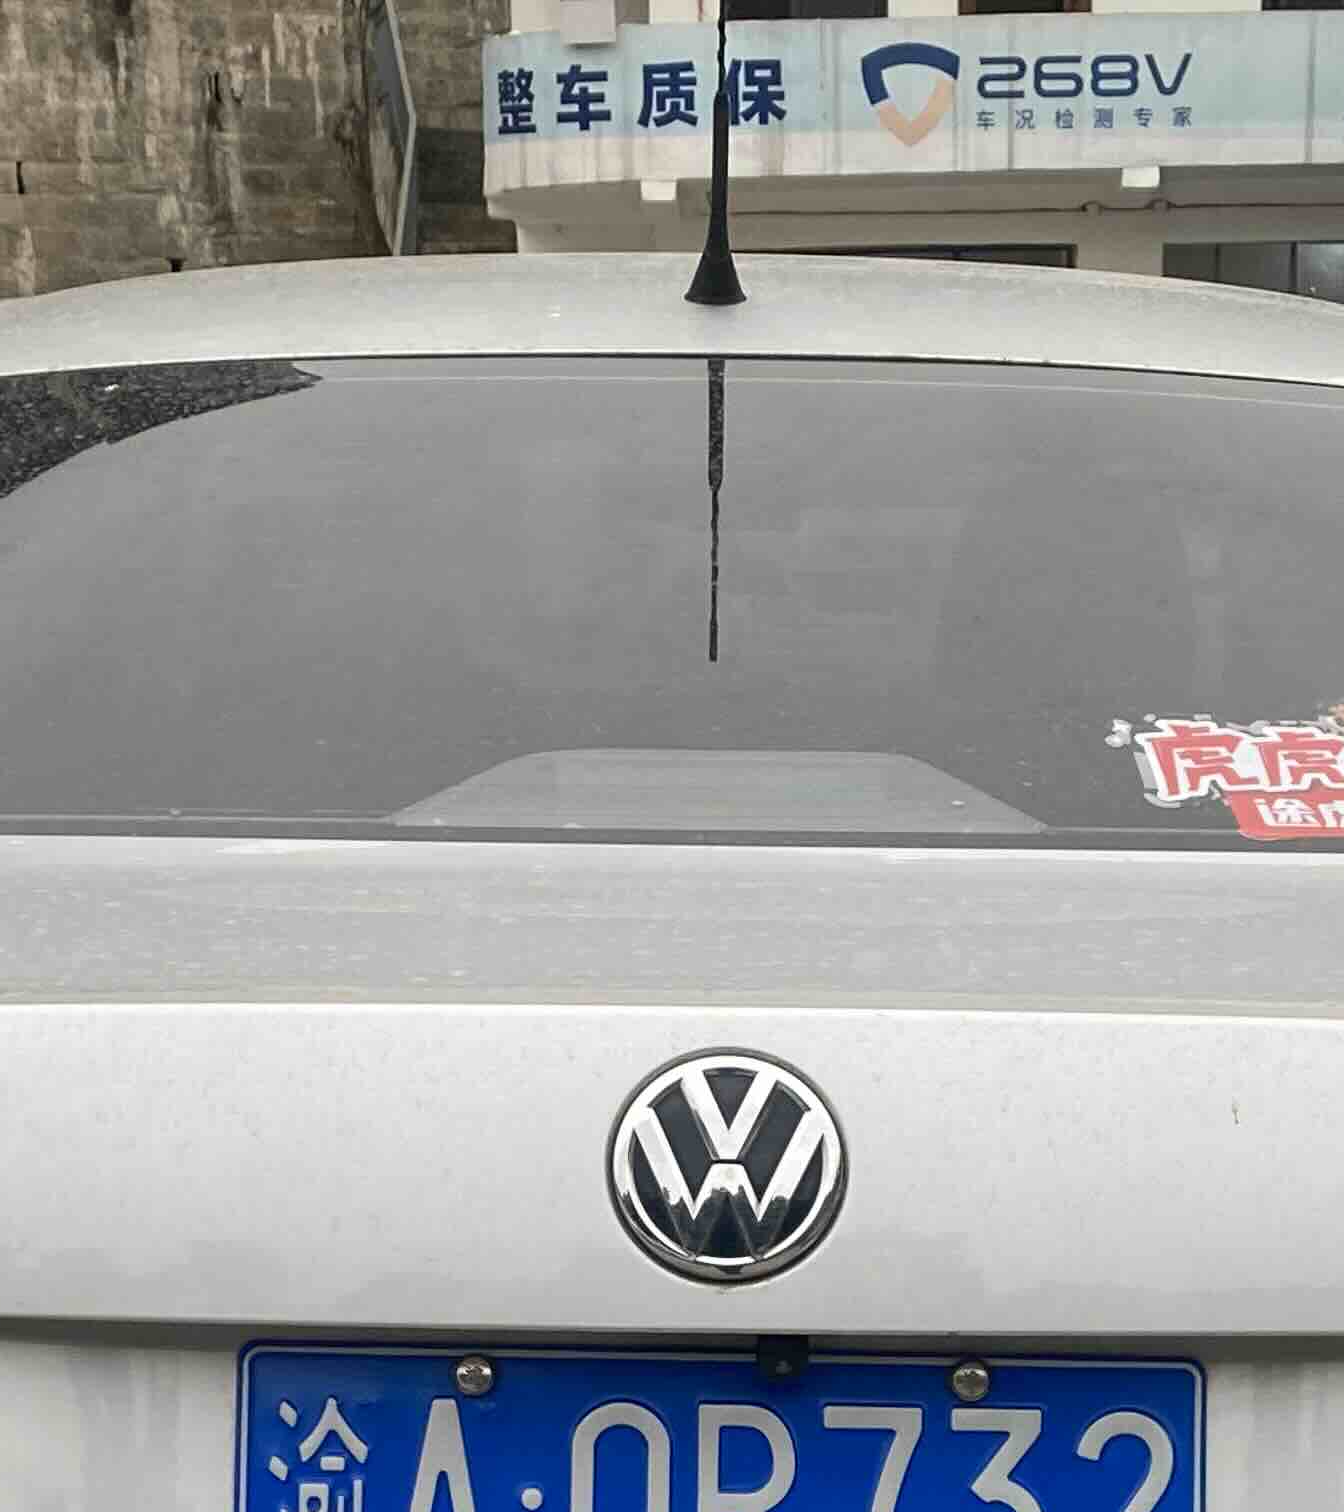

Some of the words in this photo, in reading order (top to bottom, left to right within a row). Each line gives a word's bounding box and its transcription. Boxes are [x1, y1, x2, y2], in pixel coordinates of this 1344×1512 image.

[497, 58, 787, 135] 整车质保
[976, 52, 1193, 99] 268V
[975, 105, 1193, 132] 车况检测专家
